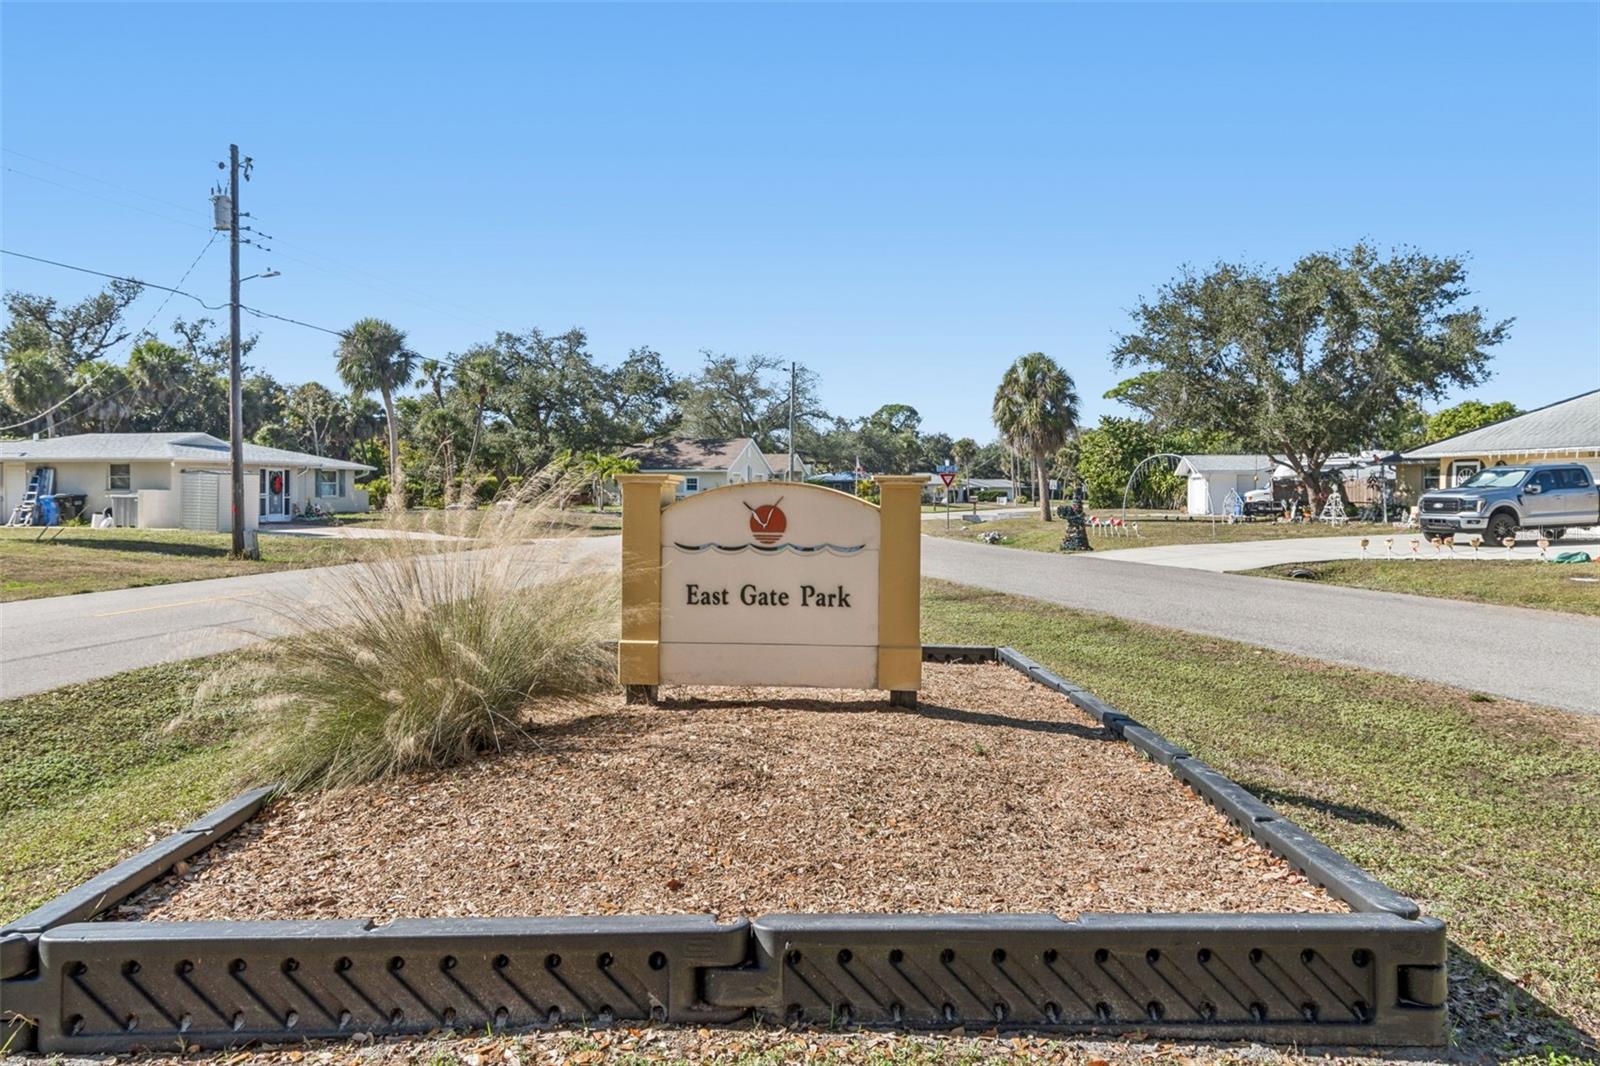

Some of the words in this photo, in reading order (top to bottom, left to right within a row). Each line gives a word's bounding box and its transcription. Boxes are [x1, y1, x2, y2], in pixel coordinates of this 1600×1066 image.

[686, 584, 729, 606] East
[740, 584, 790, 606] Gate
[800, 585, 851, 608] Park
